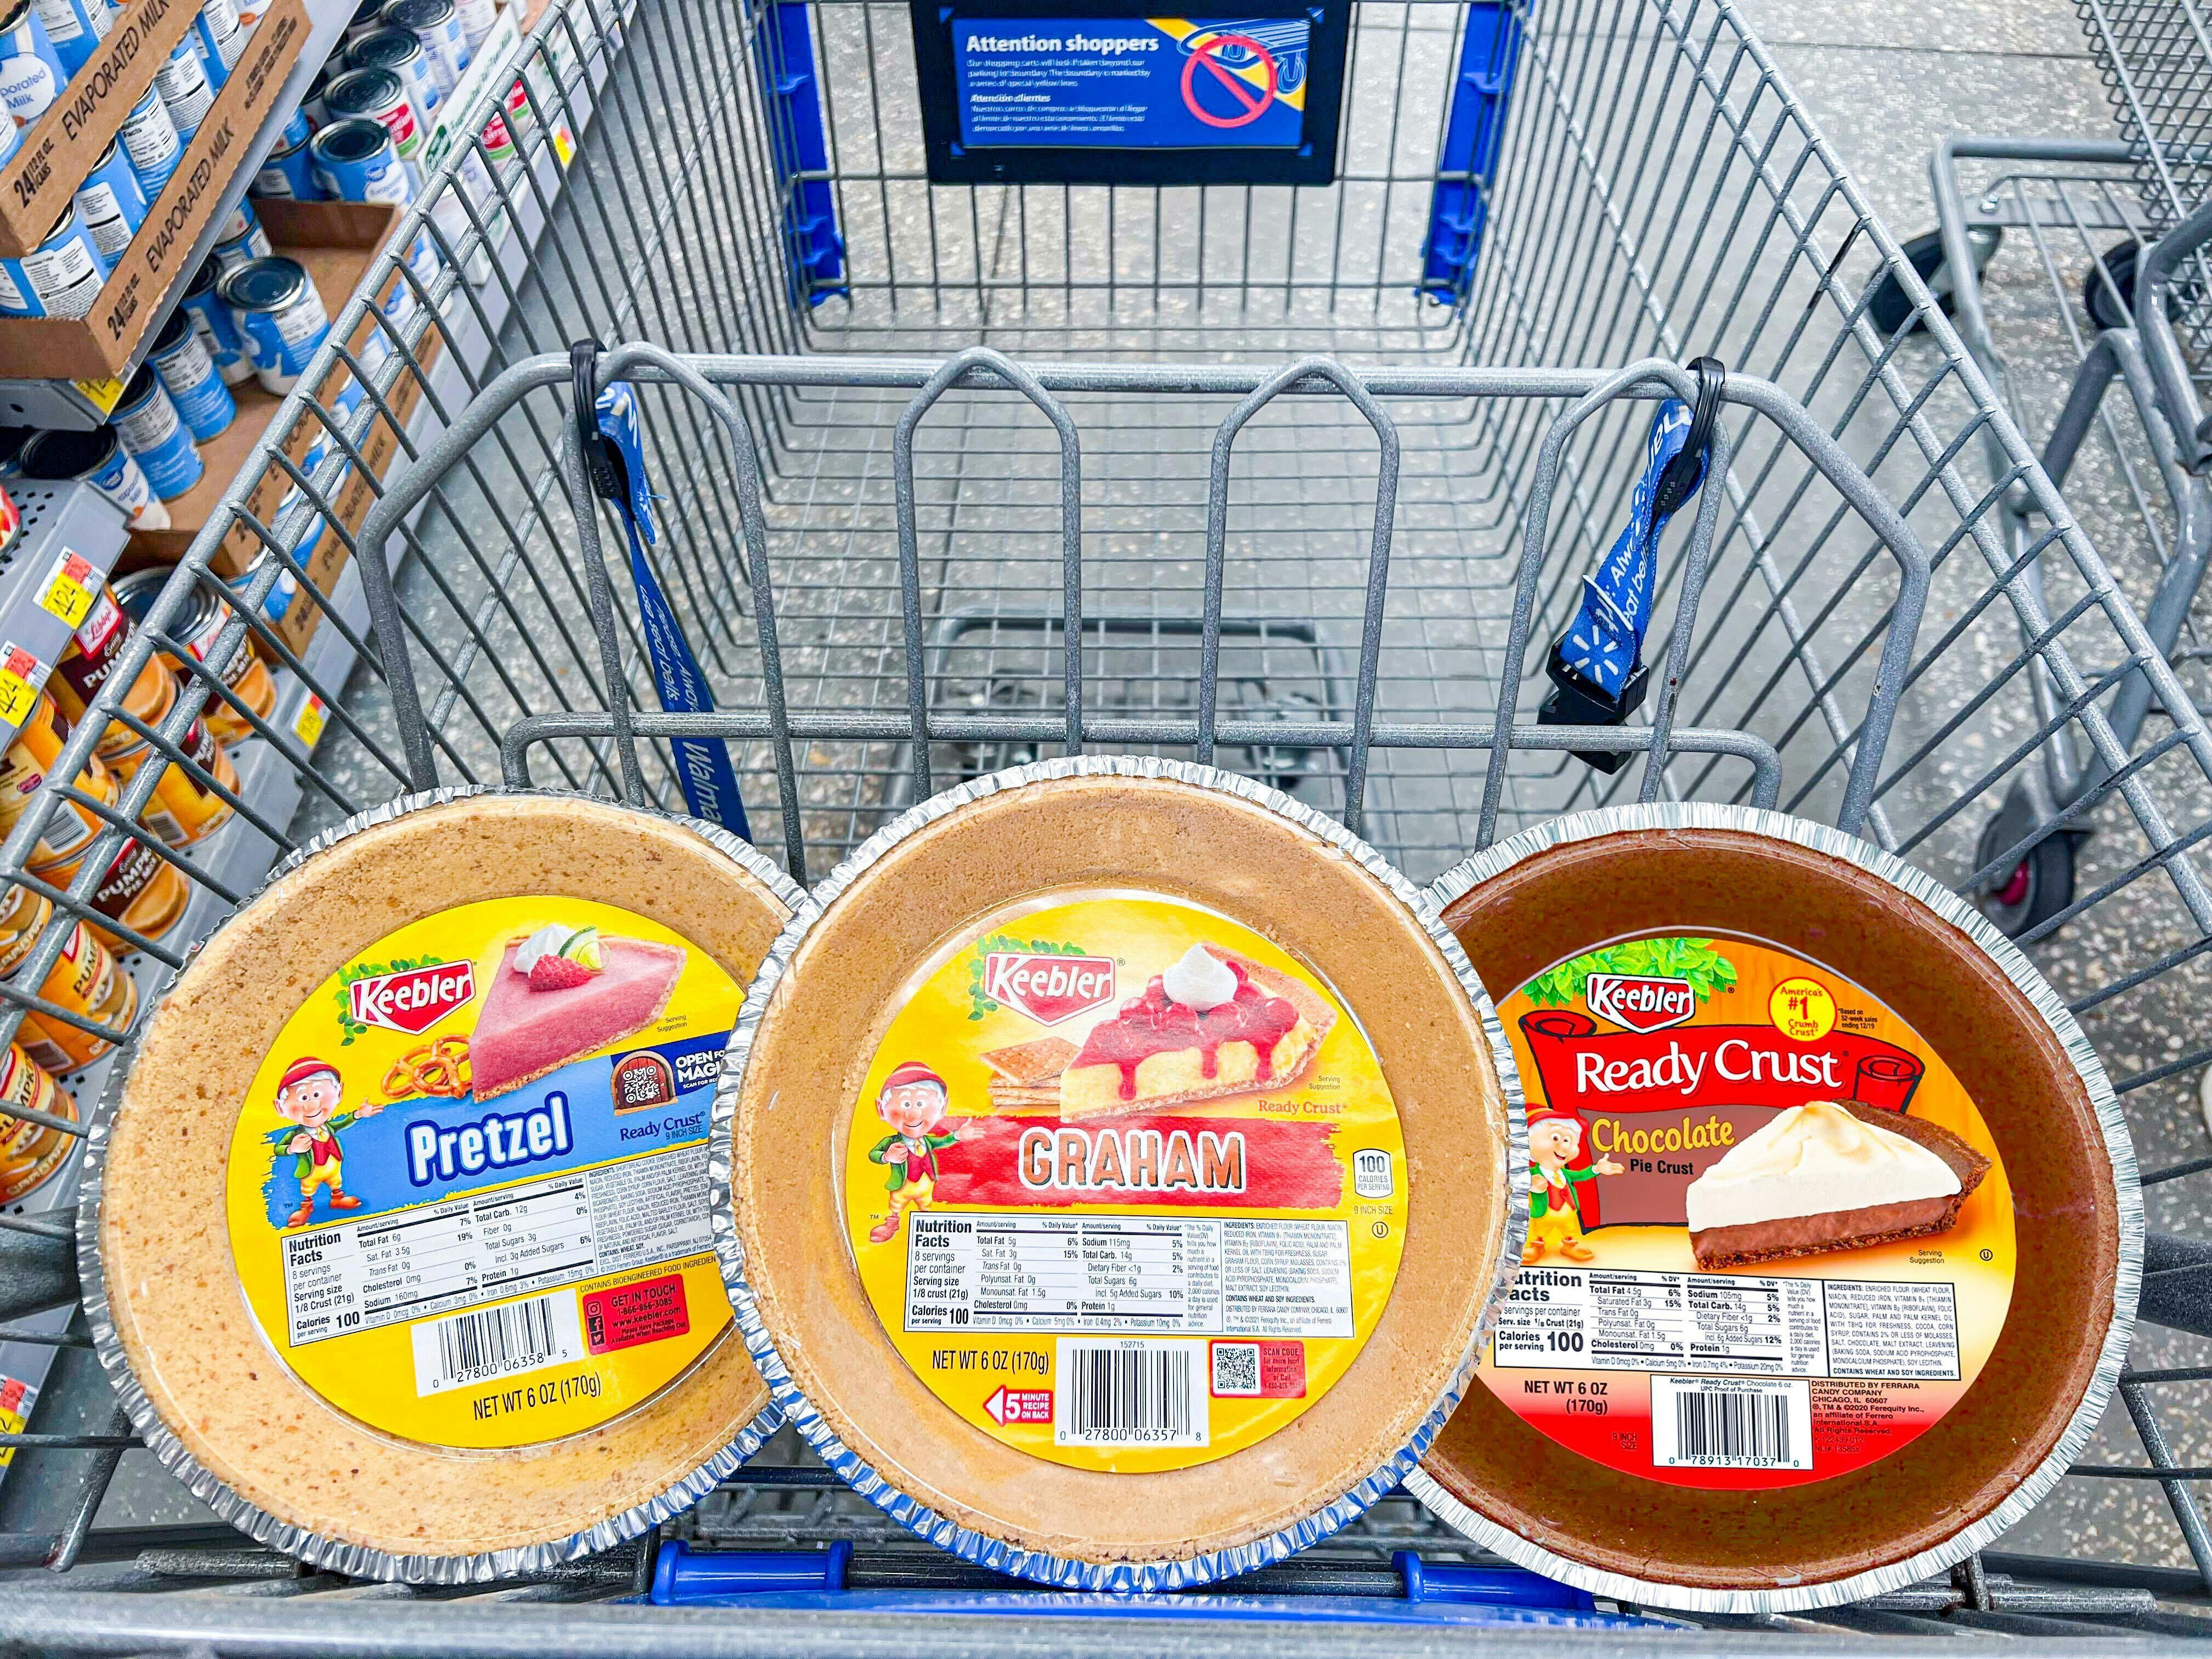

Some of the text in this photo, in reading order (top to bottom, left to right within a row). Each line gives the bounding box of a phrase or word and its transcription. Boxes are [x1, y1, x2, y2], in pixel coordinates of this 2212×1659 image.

[967, 34, 1159, 55] Attention shoppers
[61, 26, 139, 140] EVAPORATED
[7, 94, 34, 109] Milk
[145, 159, 211, 273] EVAPORATED
[208, 117, 234, 167] MILK
[684, 741, 723, 823] Walma
[990, 957, 1113, 1002] Keebler
[358, 973, 471, 1023] Keebler
[1592, 979, 1693, 1018] Keebler
[1780, 986, 1822, 996] America's
[1788, 996, 1808, 1020] #1
[657, 1021, 687, 1032] Suggestion
[665, 1014, 686, 1023] Serving
[1788, 1019, 1818, 1029] Crumb
[675, 1049, 725, 1069] OPEN FO
[1576, 1039, 1843, 1096] Ready Crust
[678, 1059, 722, 1083] MAGI
[1258, 1099, 1300, 1115] Ready
[408, 1094, 569, 1183] Pretzel
[620, 1121, 661, 1141] Ready
[672, 1128, 686, 1138] INCH
[689, 1125, 702, 1135] SIZE
[1592, 1115, 1735, 1154] Chocolate
[1022, 1130, 1243, 1190] GRAHAM
[1359, 1155, 1385, 1173] 100
[1630, 1159, 1694, 1175] Pie Crust
[1354, 1206, 1393, 1215] 9 INCH SIZE
[916, 1219, 972, 1233] Nutrition
[289, 1232, 341, 1252] Nutrition
[915, 1234, 950, 1248] Facts
[1082, 1238, 1130, 1249] Sodium 115mg
[290, 1250, 323, 1267] Facts
[580, 1255, 716, 1293] CONTAINS BIOENGINEERED FOOD INGREDIEN
[913, 1276, 960, 1288] Serving size
[1514, 1271, 1582, 1287] utrition
[294, 1284, 342, 1302] Serving size
[363, 1274, 421, 1294] Cholesterol 0mg
[295, 1293, 354, 1313] 1/8 Crust (21g)
[364, 1291, 417, 1308] Sodium 160mg
[611, 1283, 677, 1308] GET IN TOUCH
[913, 1289, 968, 1300] 1/8 crust (21g)
[1509, 1287, 1550, 1301] acts
[974, 1300, 1028, 1310] Cholesterol 0mg
[297, 1312, 360, 1330] Calories 100
[611, 1306, 681, 1329] www.keebler.com
[912, 1305, 968, 1324] Calories 100
[1498, 1318, 1517, 1326] Serv.
[1534, 1318, 1544, 1327] 1/8
[1546, 1319, 1565, 1327] Crust
[1566, 1320, 1584, 1329] (21g)
[1120, 1341, 1144, 1349] 152715
[1499, 1331, 1584, 1352] Calories 100
[1263, 1348, 1280, 1356] SCAN
[456, 1352, 544, 1383] 27800 06358
[932, 1350, 1049, 1375] NET WT 6 OZ (170g)
[473, 1372, 602, 1420] NET WT 6 OZ (170g)
[1525, 1380, 1608, 1395] NET WT 6 OZ
[1004, 1393, 1021, 1420] 5
[1022, 1393, 1049, 1402] MINUTE
[1023, 1402, 1049, 1410] RECIPE
[1022, 1410, 1049, 1419] ON BACK
[1565, 1399, 1608, 1415] (170g)
[1085, 1429, 1177, 1442] 27800 06357
[1691, 1455, 1776, 1467] 78913 17037
